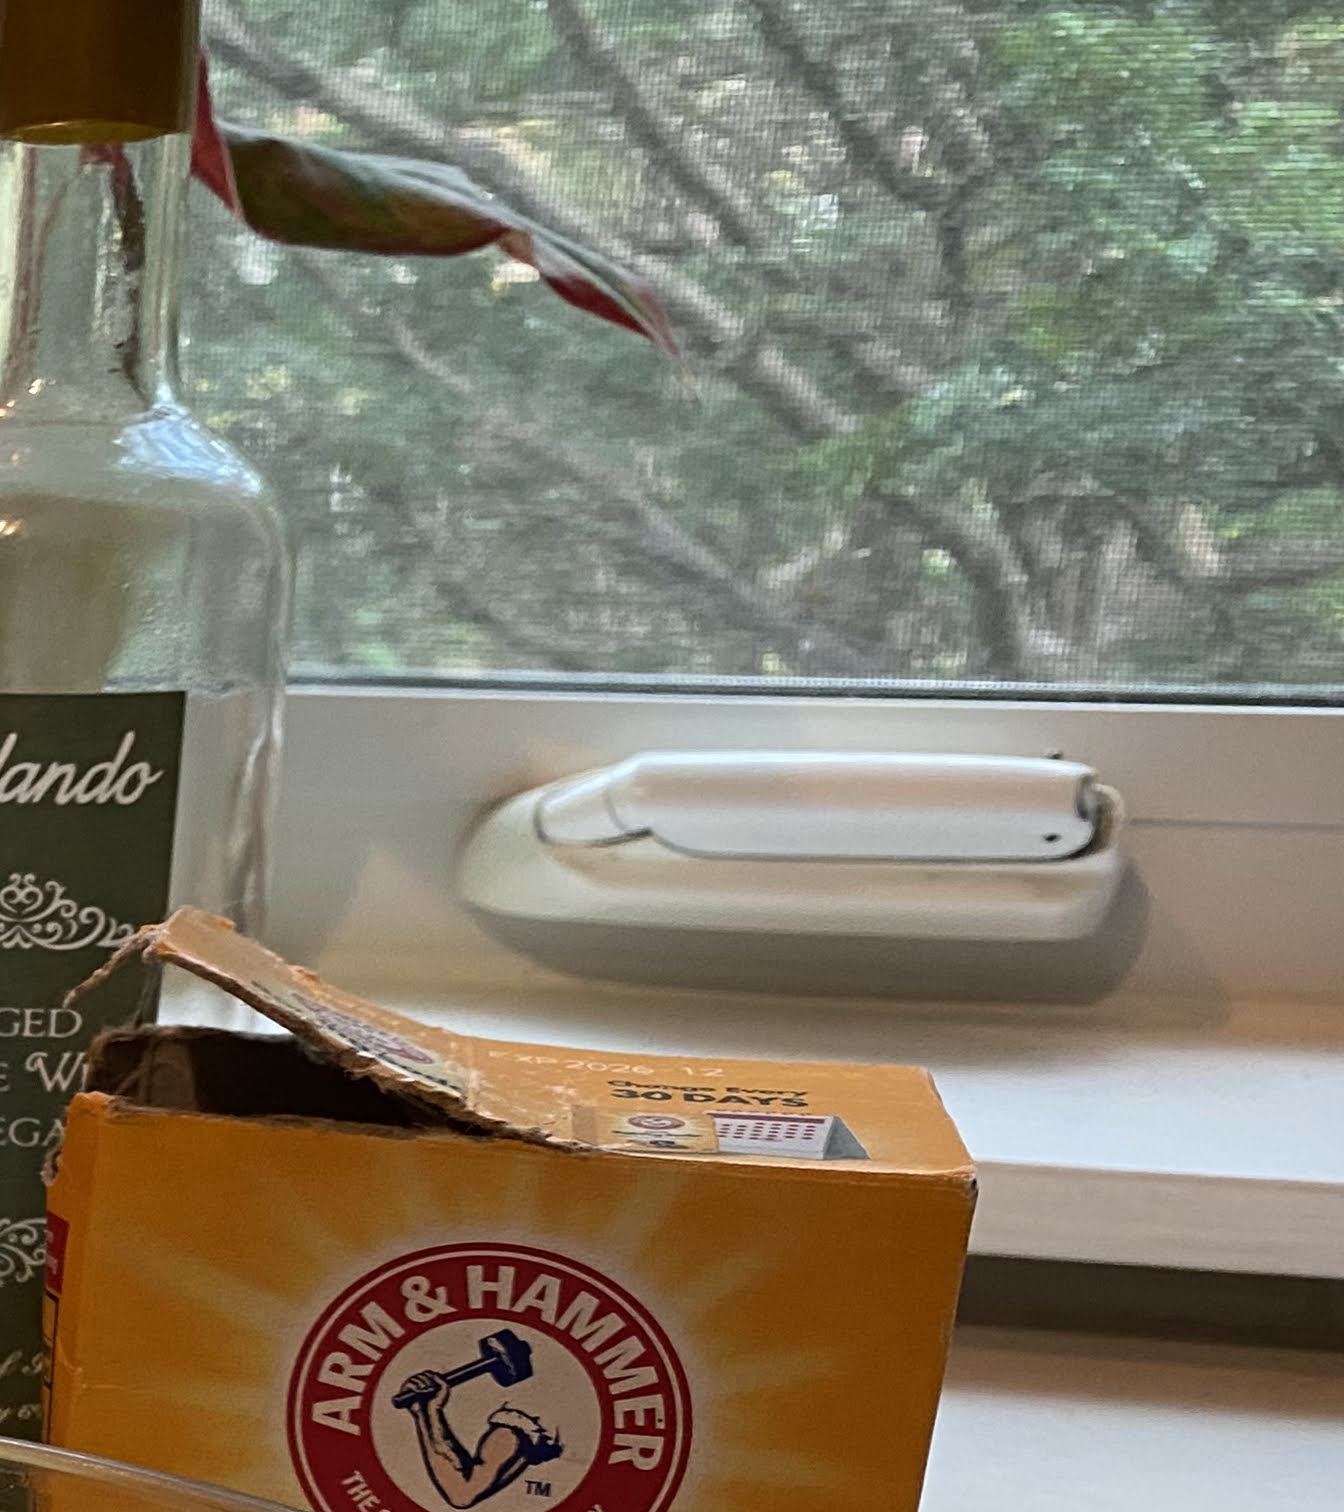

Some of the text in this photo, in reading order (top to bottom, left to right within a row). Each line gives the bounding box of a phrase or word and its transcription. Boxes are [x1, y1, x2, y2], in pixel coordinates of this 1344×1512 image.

[488, 1050, 558, 1066] EXP
[565, 1059, 655, 1076] 2026
[607, 1080, 809, 1097] Change Every
[611, 1088, 809, 1108] 30 DAYS
[312, 1263, 668, 1472] ARM & HAMMER
[524, 1480, 552, 1499] TM
